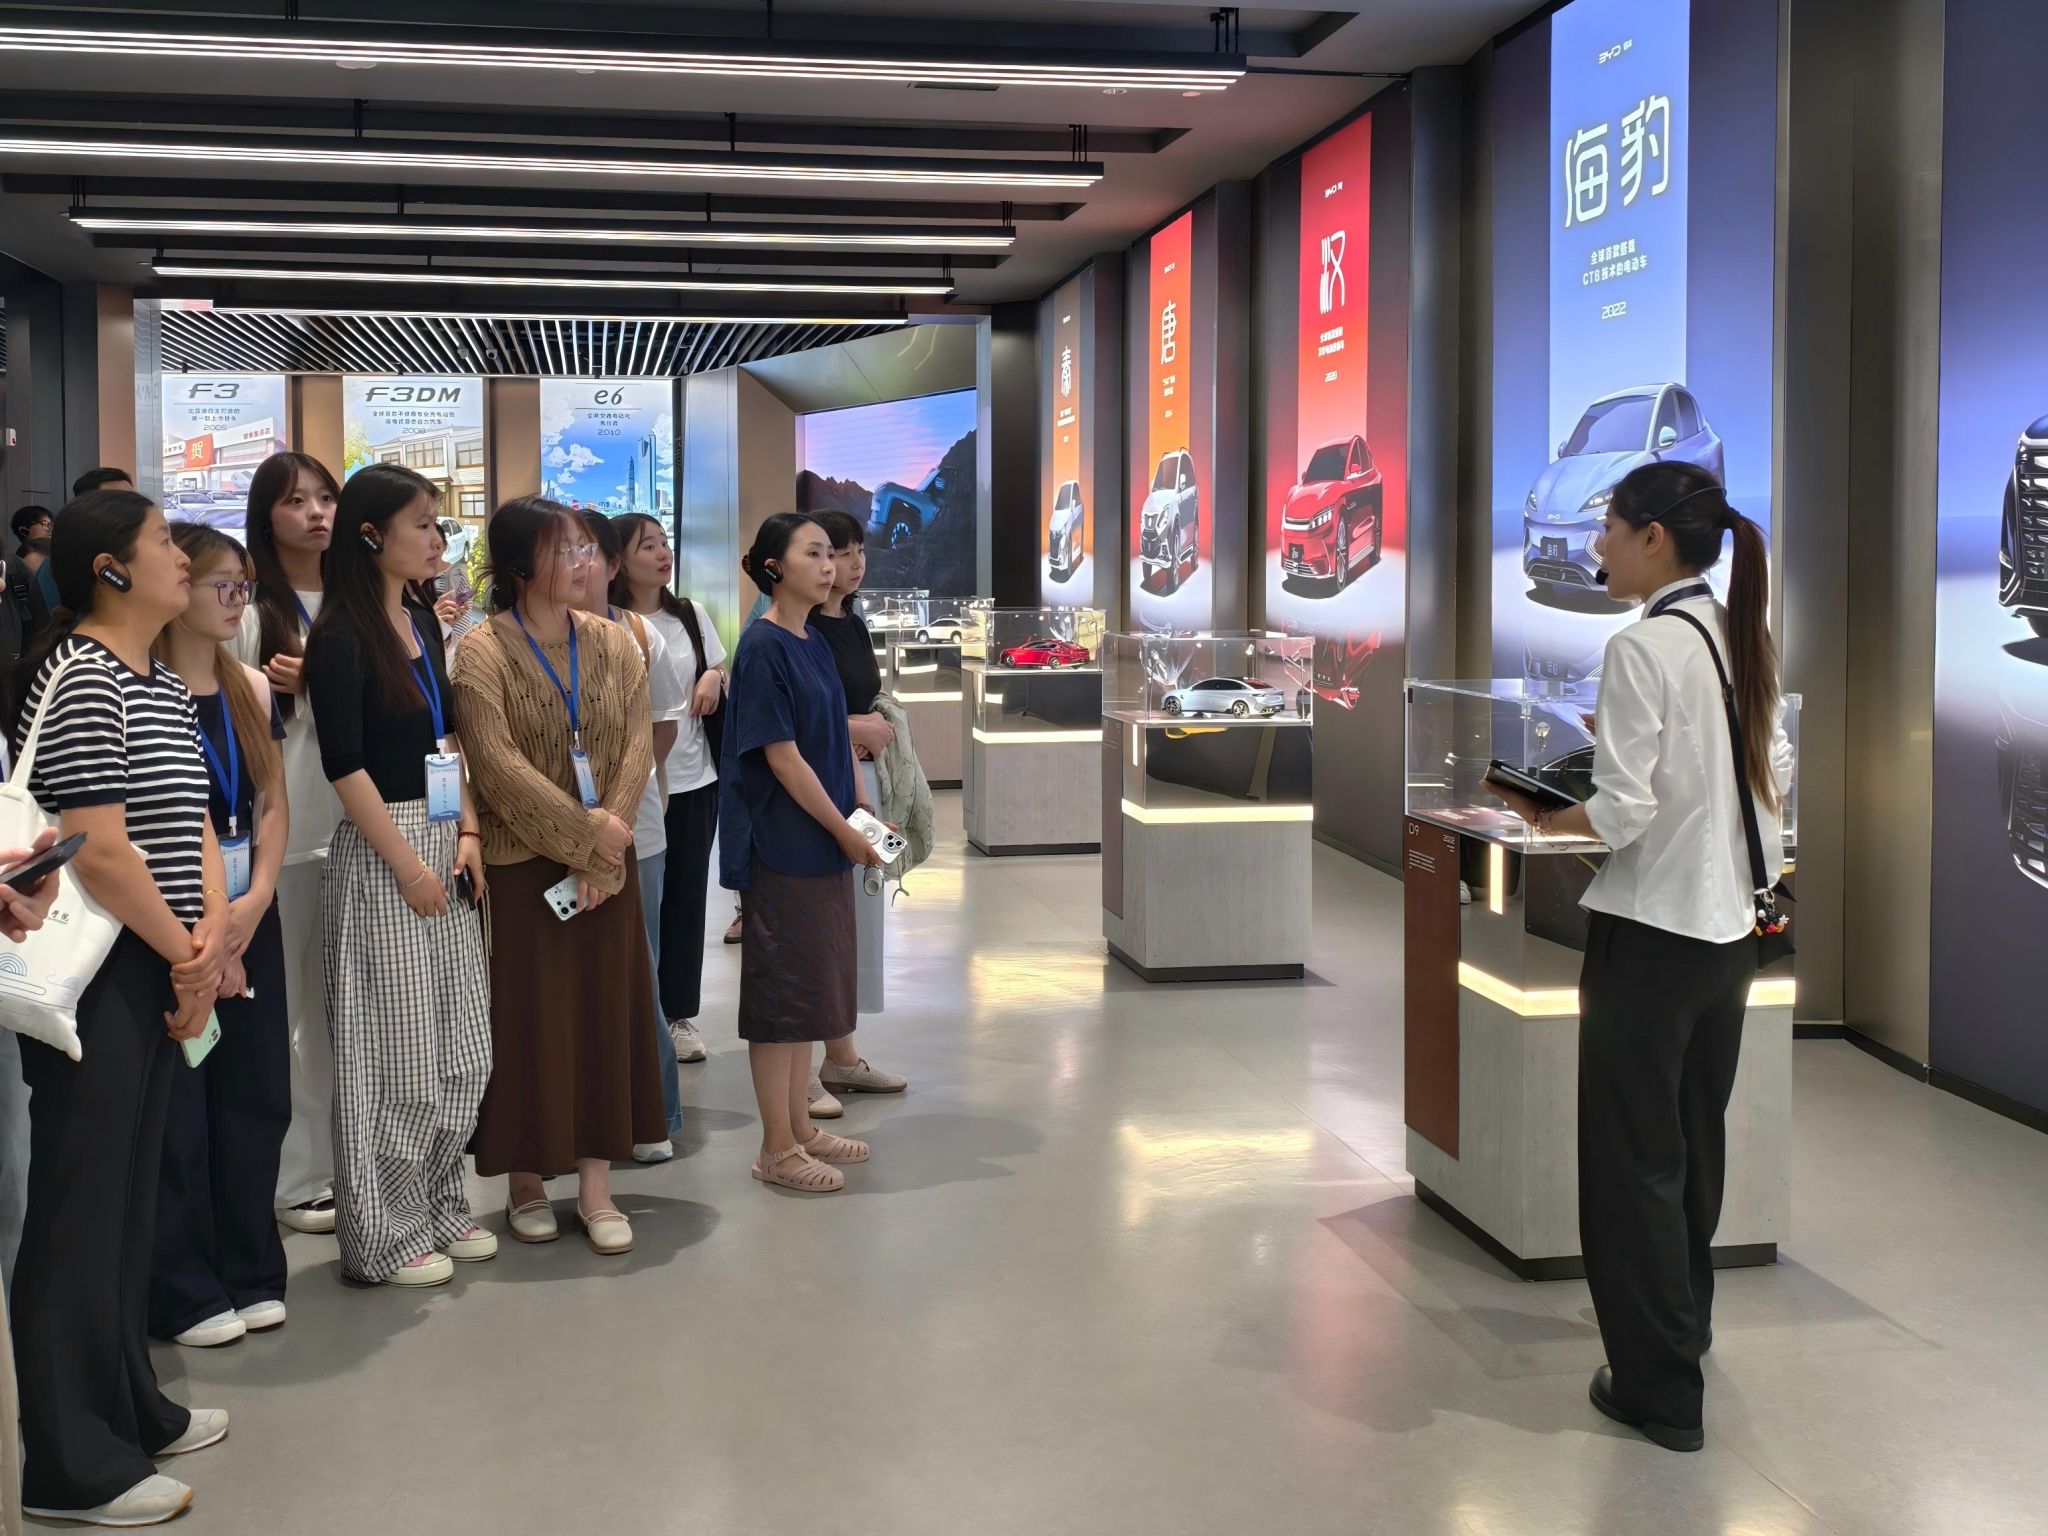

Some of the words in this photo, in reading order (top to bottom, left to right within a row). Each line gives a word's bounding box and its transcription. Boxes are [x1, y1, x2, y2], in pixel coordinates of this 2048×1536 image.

[1565, 94, 1669, 228] 海豹
[1583, 269, 1600, 286] CTB
[1601, 301, 1626, 319] 2022
[1161, 300, 1176, 365] 唐
[188, 383, 240, 399] F3
[365, 386, 461, 403] F3DM
[594, 386, 625, 405] e6
[192, 441, 203, 460] 贺
